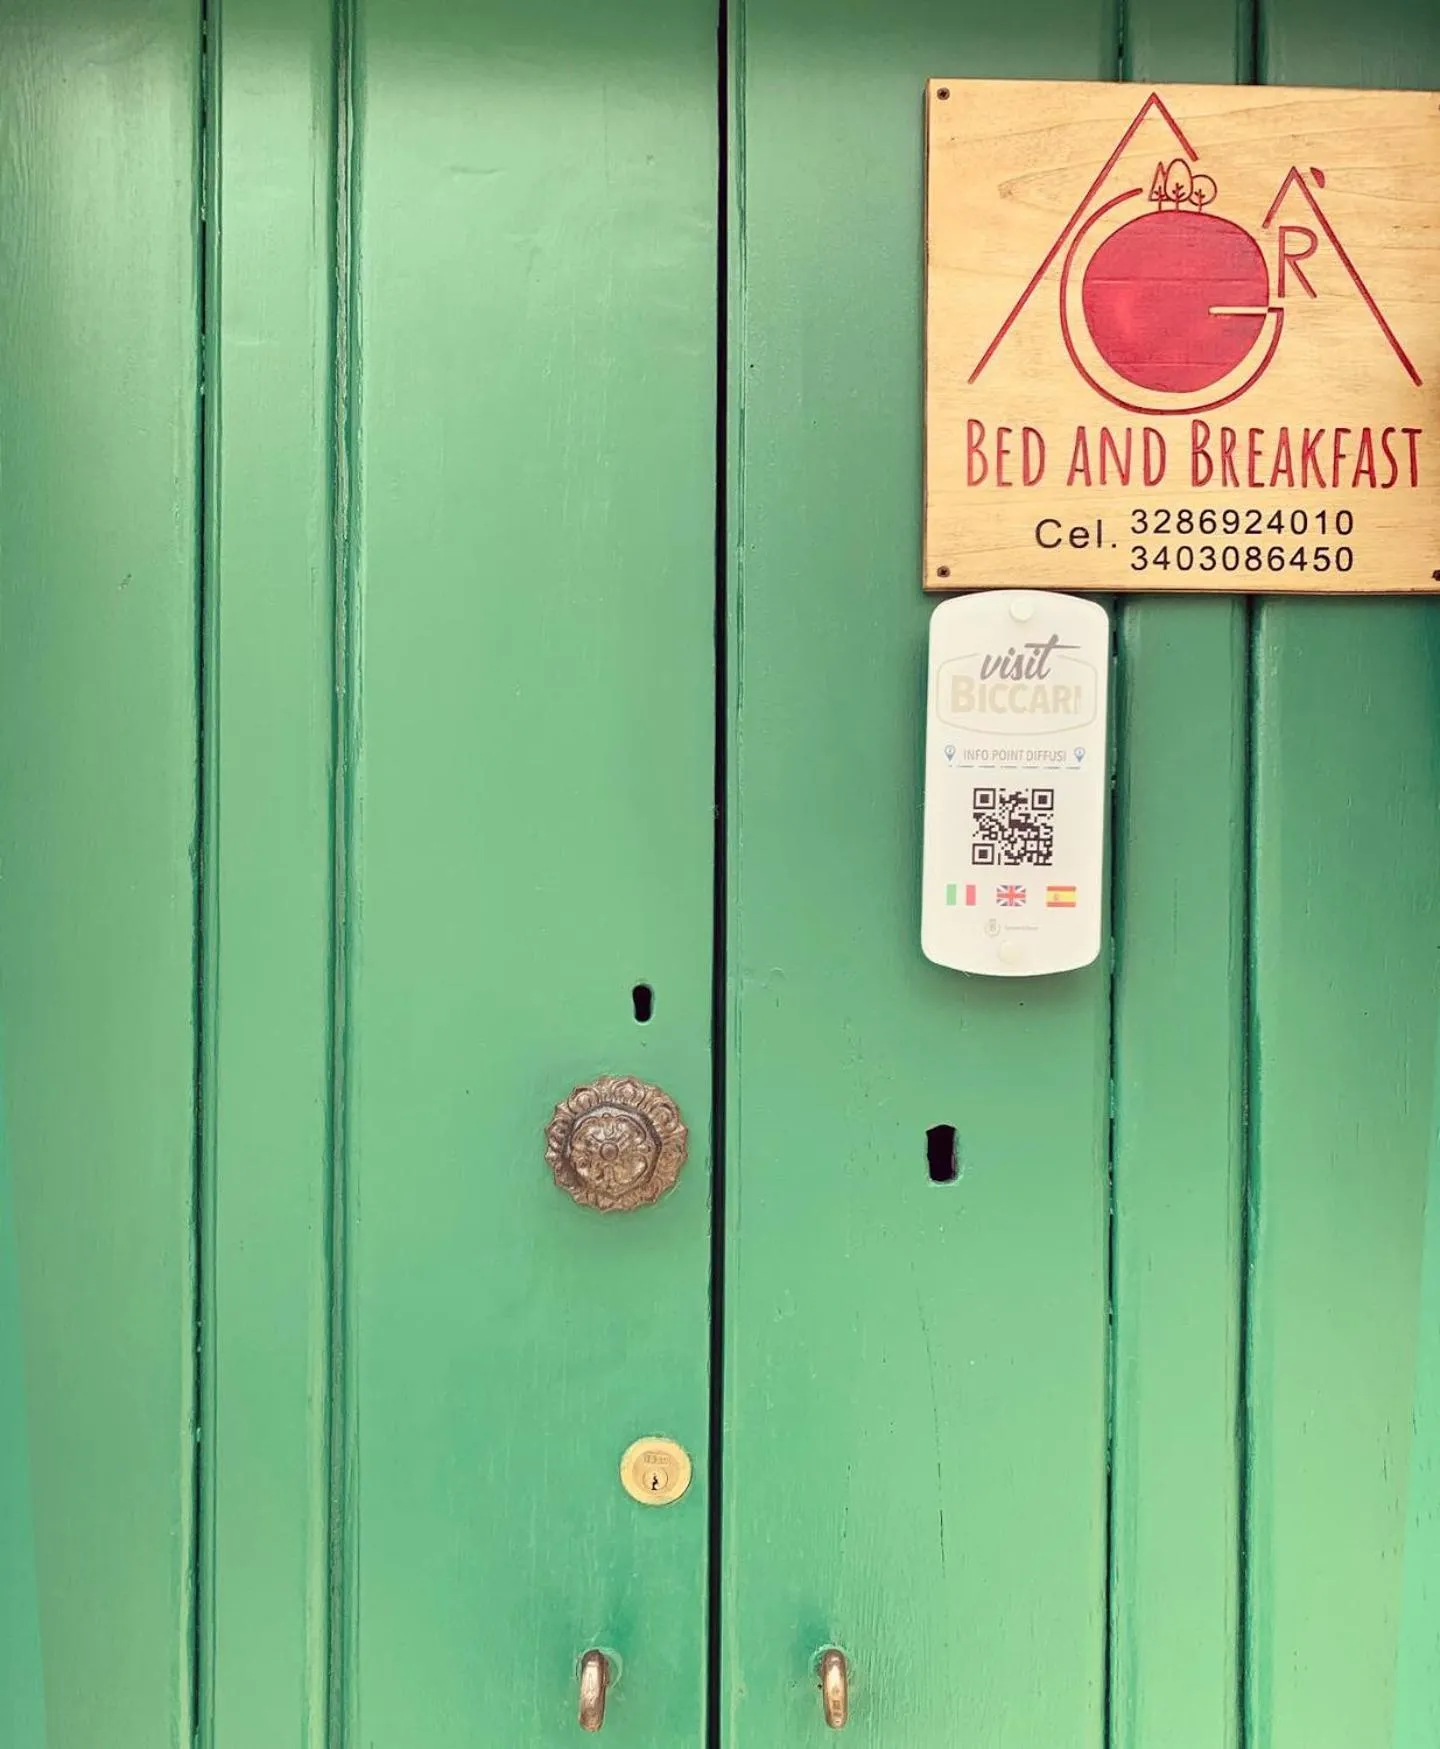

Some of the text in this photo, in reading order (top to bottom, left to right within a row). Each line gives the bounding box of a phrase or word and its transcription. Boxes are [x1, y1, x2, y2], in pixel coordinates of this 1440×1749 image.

[966, 418, 1423, 488] BED AND BREAKFAST
[1034, 509, 1354, 550] Cel. 3286924010
[1130, 545, 1354, 572] 3403086450
[979, 633, 1082, 680] visit
[951, 674, 1082, 715] BICCARI
[963, 748, 1067, 763] INFO POINT DIFFUSI
